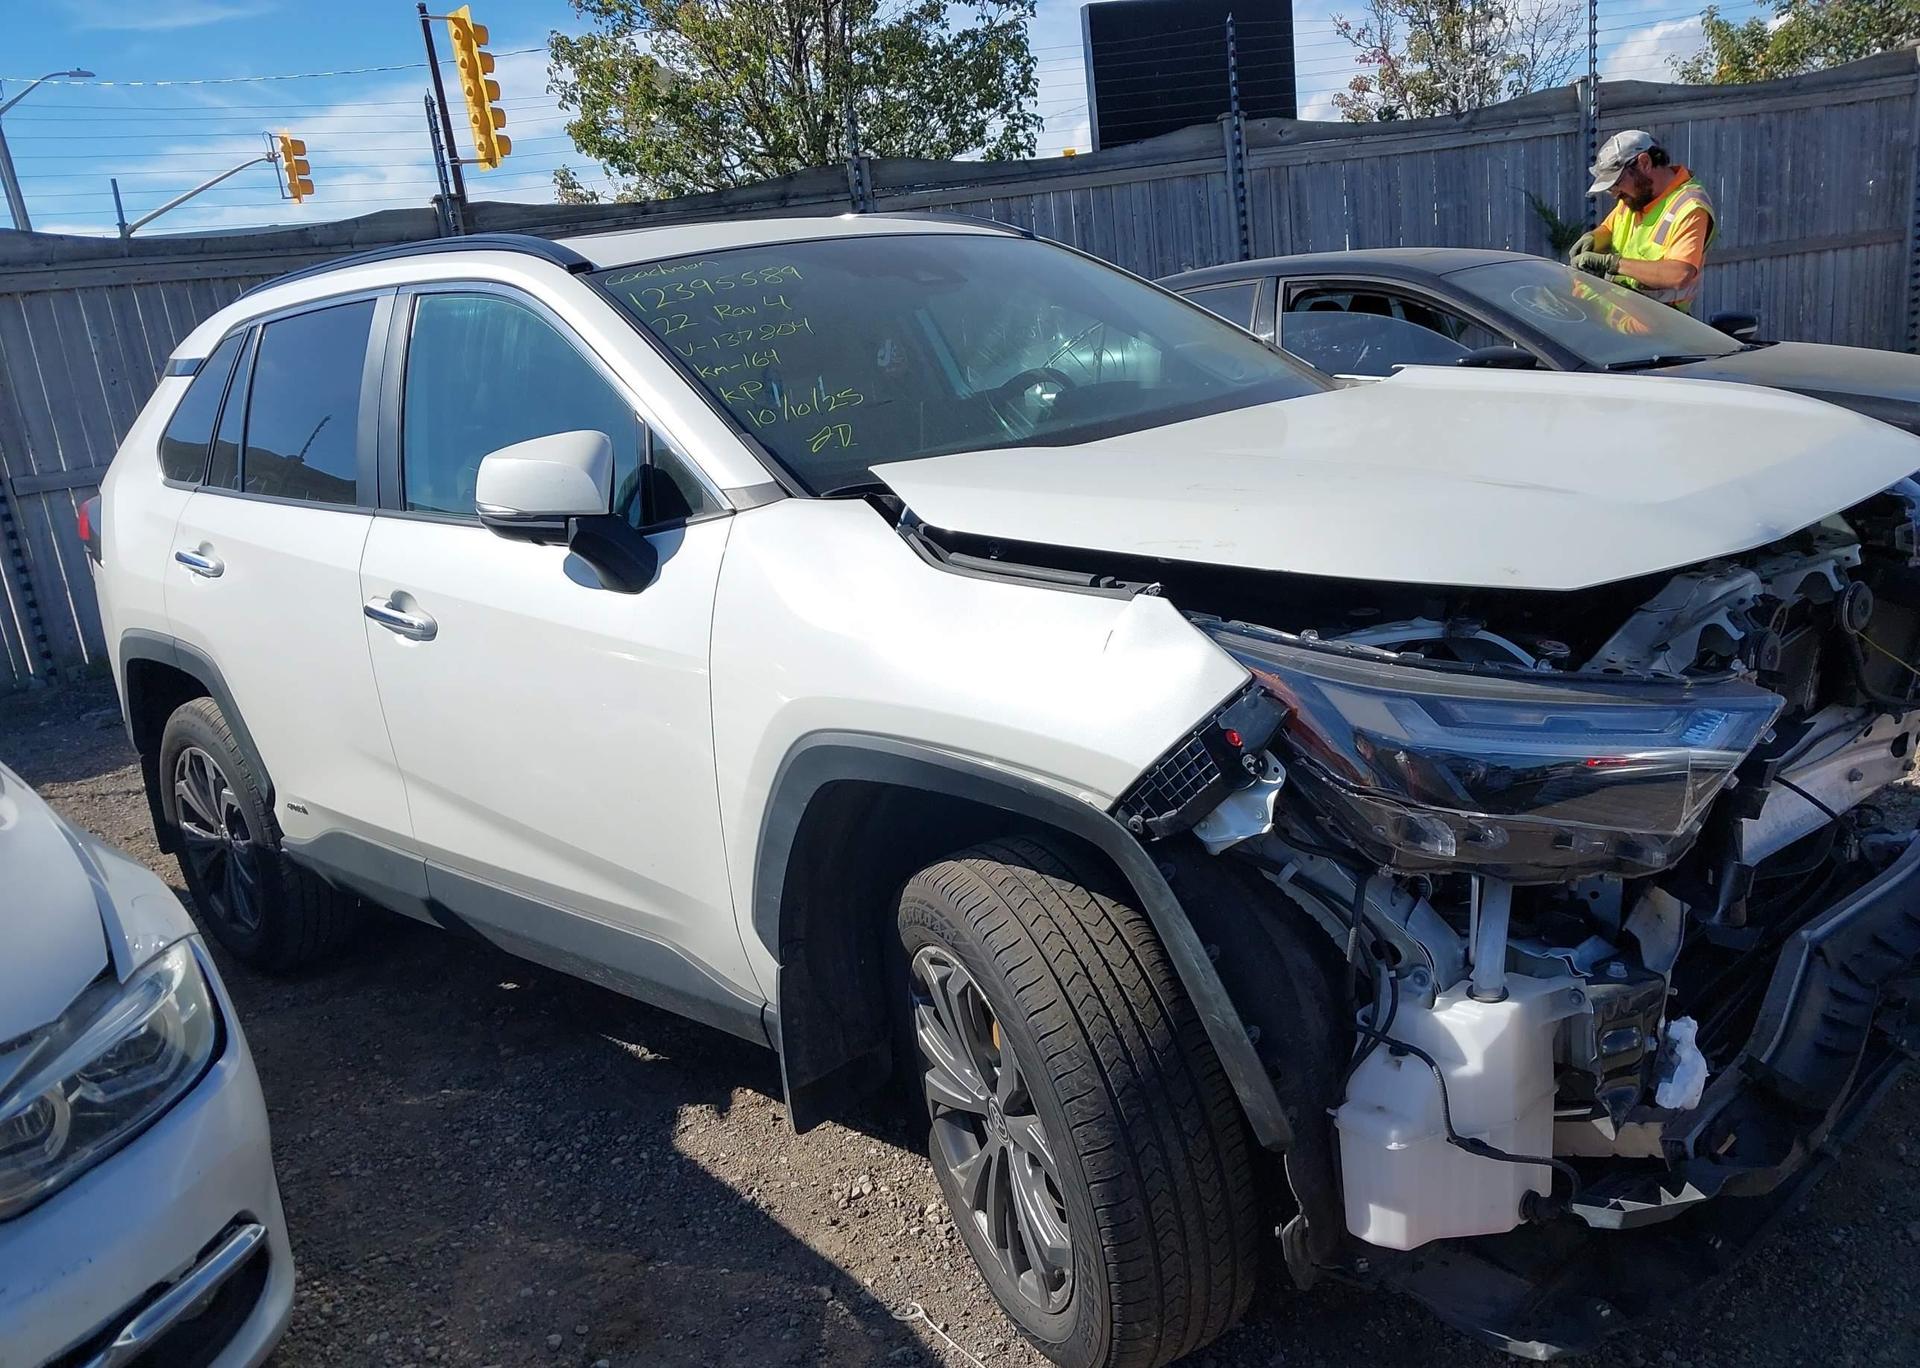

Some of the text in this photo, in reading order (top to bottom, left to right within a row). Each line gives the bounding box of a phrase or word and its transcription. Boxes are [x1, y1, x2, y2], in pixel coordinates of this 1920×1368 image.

[628, 265, 803, 312] 12395589
[650, 295, 792, 335] 22 Rav 4
[747, 387, 865, 429] 10/10/25
